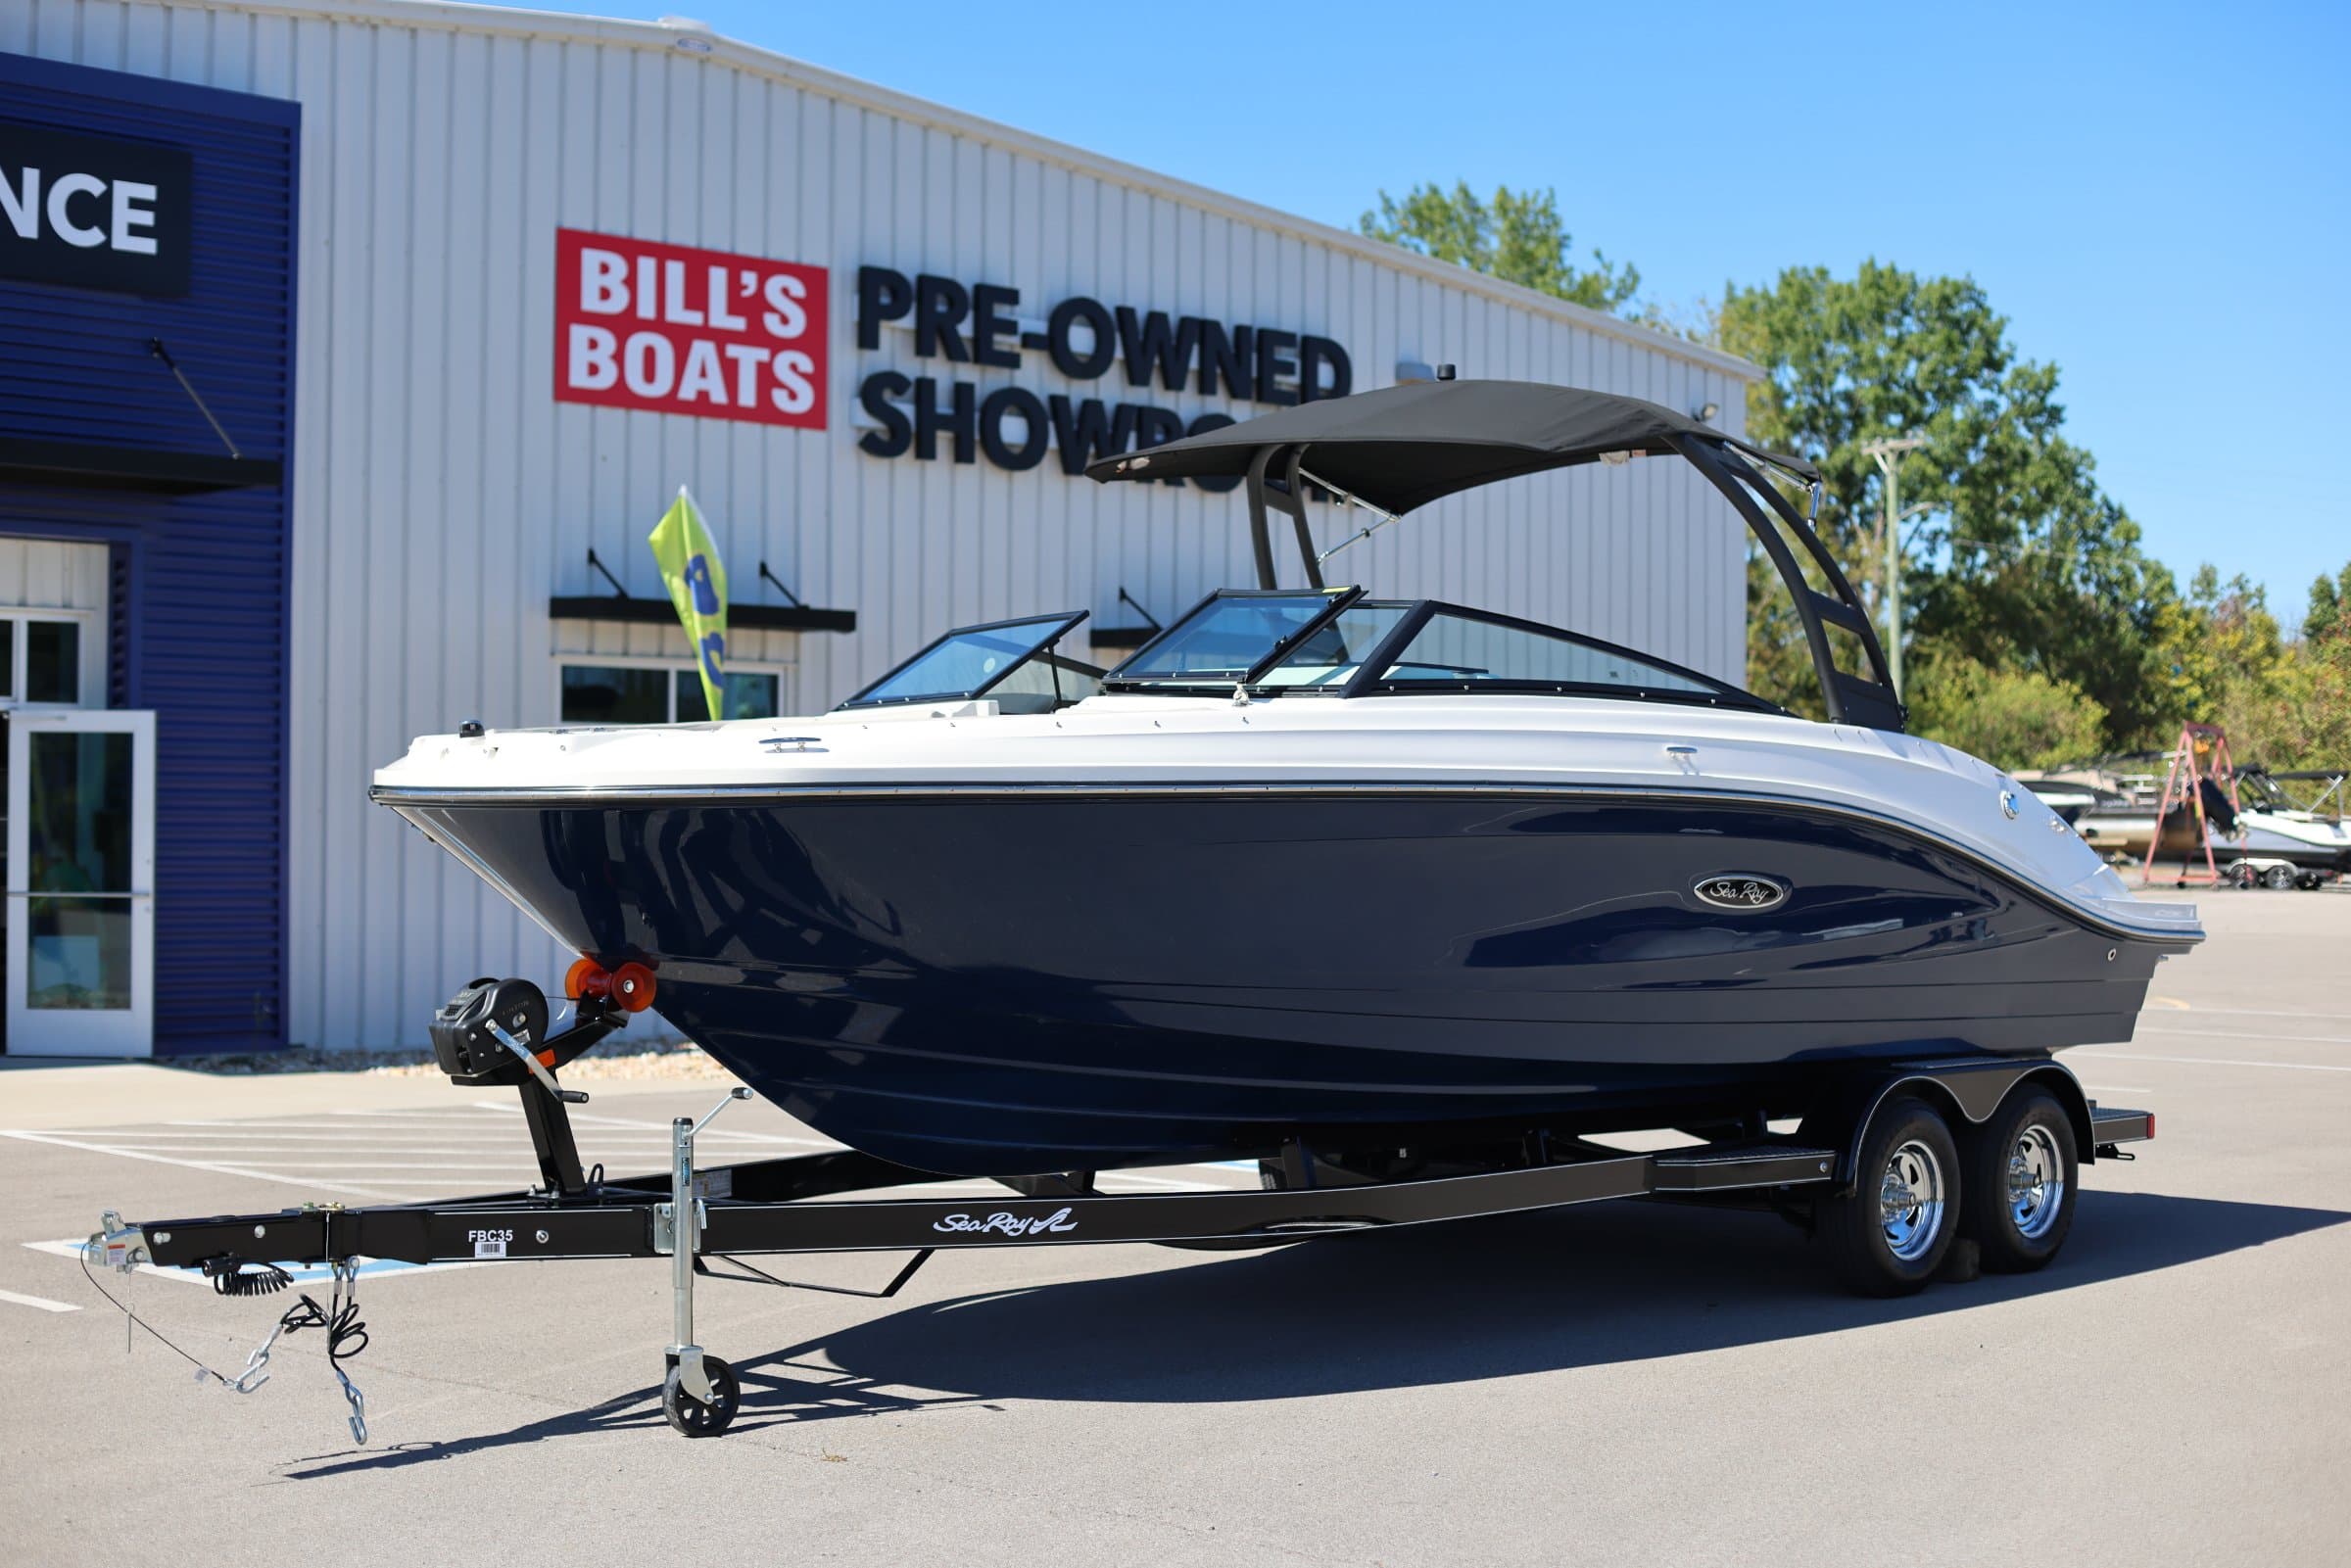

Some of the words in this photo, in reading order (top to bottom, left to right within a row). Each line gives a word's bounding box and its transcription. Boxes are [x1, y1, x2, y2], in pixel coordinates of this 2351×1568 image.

[580, 246, 808, 340] BILL'S
[857, 264, 1353, 406] PRE-OWNED
[567, 322, 816, 415] BOATS
[1709, 881, 1739, 899] Sea
[1739, 881, 1770, 905] Ray
[468, 1229, 513, 1243] FBC35
[933, 1213, 984, 1233] Sea
[982, 1212, 1034, 1237] Ray
